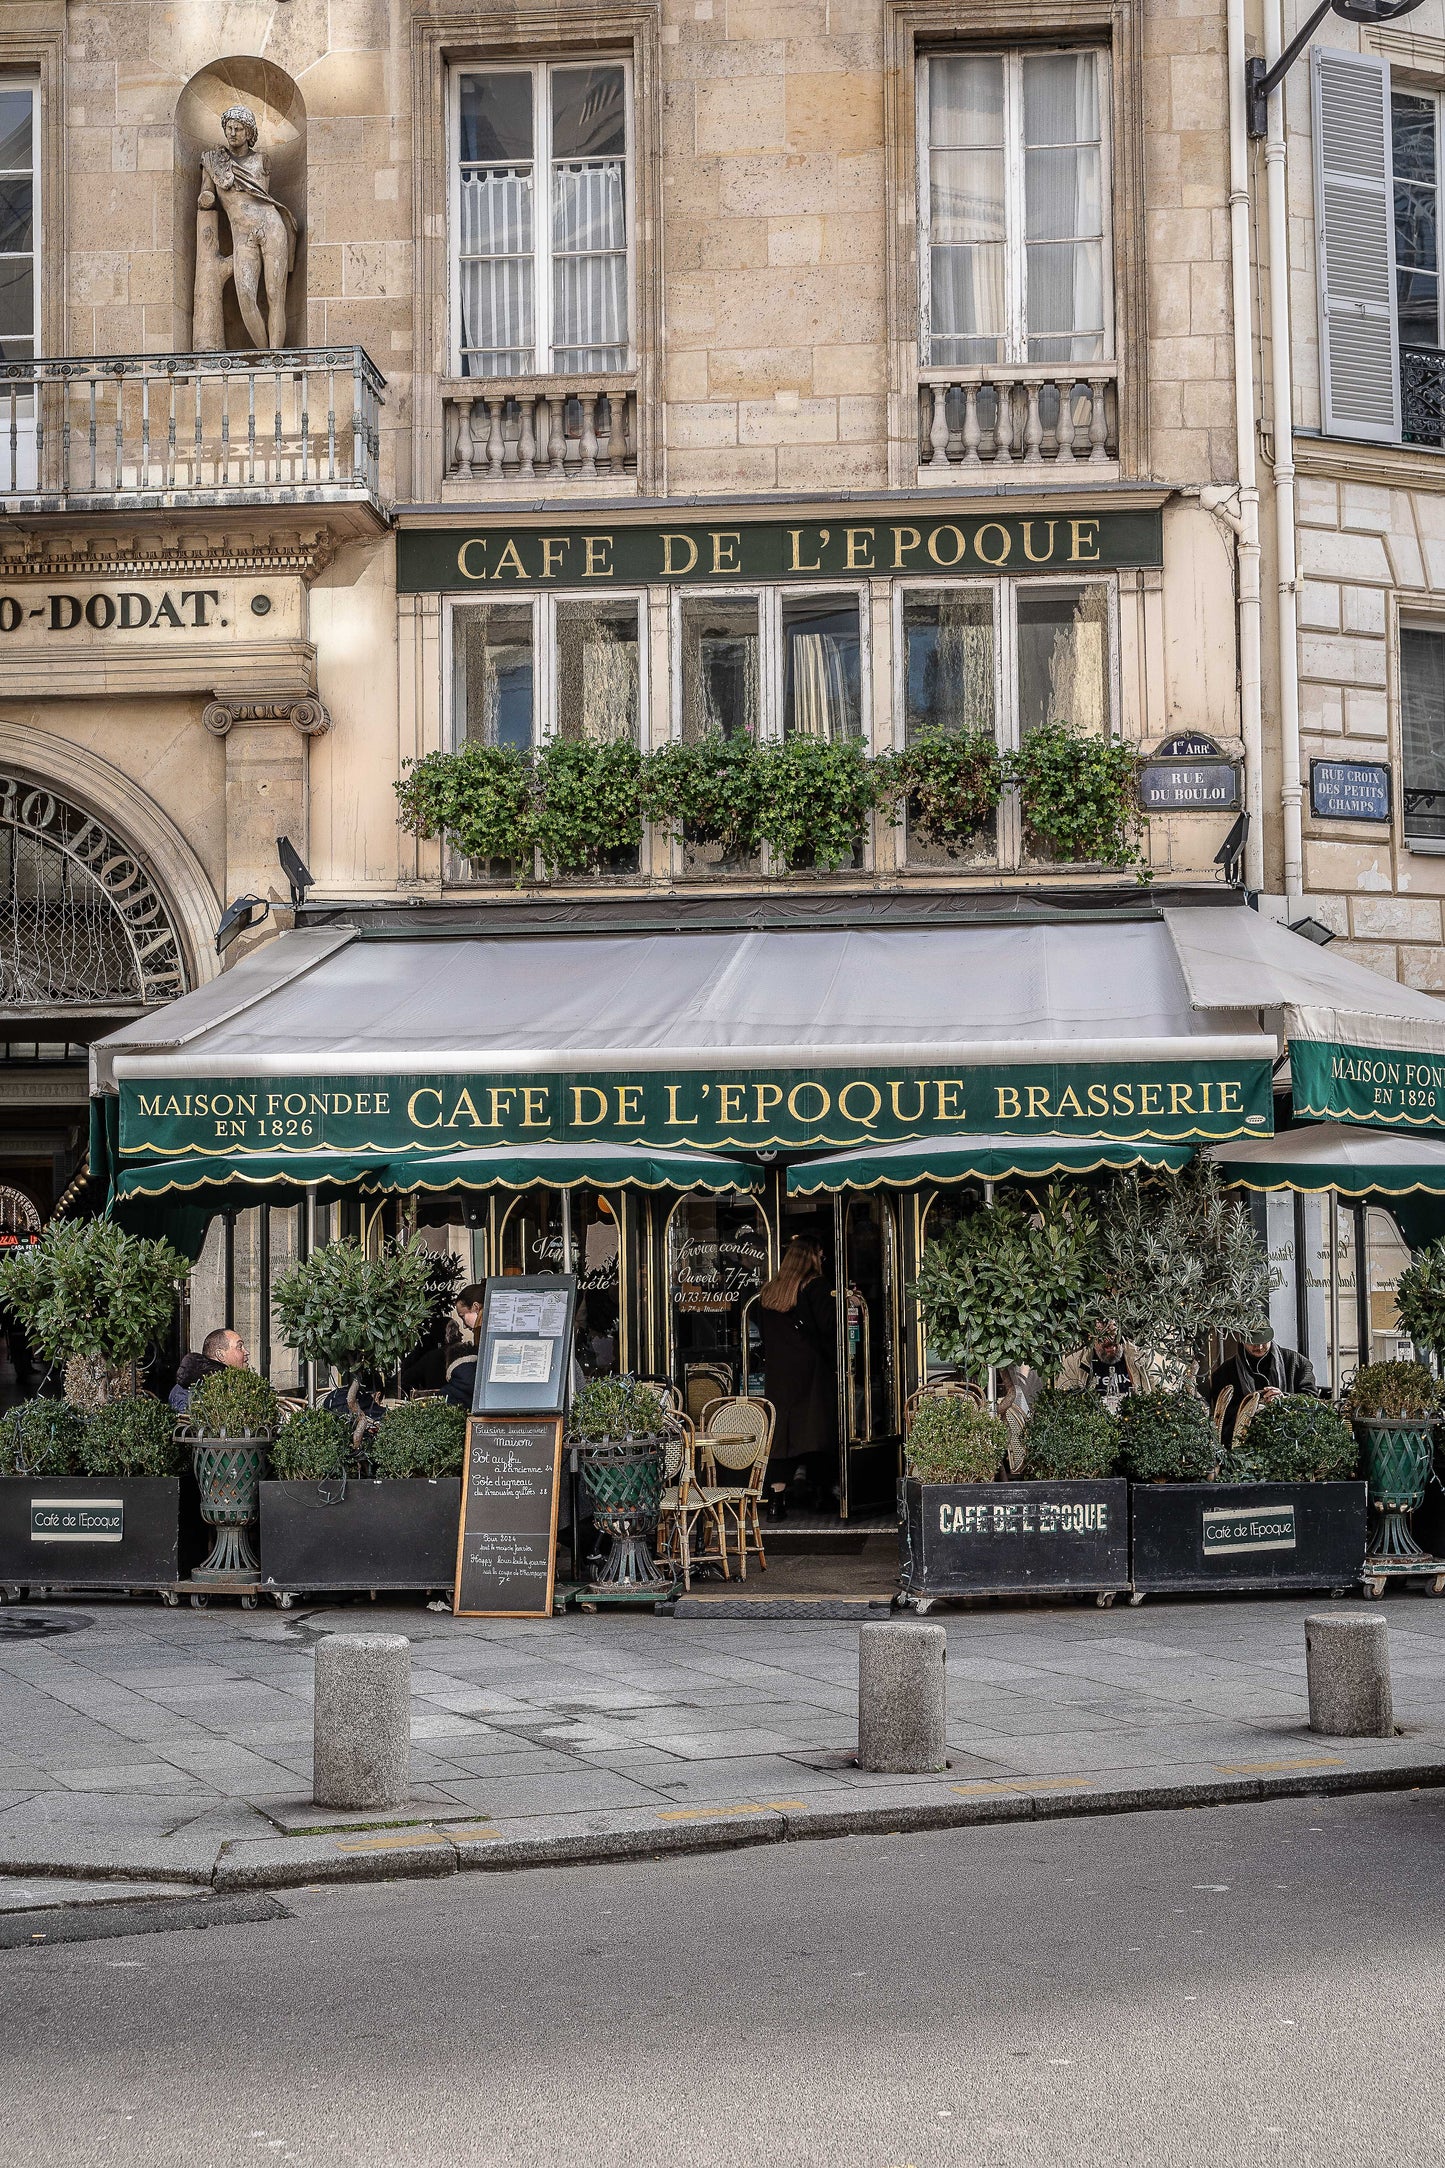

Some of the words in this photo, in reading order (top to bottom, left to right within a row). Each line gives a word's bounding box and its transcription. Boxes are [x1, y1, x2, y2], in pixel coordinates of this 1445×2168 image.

[457, 535, 614, 580] CAFE
[659, 532, 741, 575] DE
[787, 519, 1100, 571] L'EPOQUE
[1171, 772, 1204, 784] RUE
[1321, 768, 1344, 781] RUE
[1347, 771, 1380, 783] CROIX
[1150, 789, 1170, 801] DU
[1174, 788, 1226, 800] BOULOI
[1318, 782, 1340, 794] DES
[1344, 785, 1384, 798] PETITS
[1328, 799, 1377, 813] CHAMPS.
[1331, 1056, 1400, 1085] MAISON
[1405, 1064, 1445, 1088] FON
[138, 1094, 257, 1116] MAISON
[266, 1093, 391, 1115] FONDEE
[407, 1087, 552, 1129] CAFE
[569, 1086, 646, 1126] DE
[663, 1080, 966, 1128] L'EPOQUE
[994, 1082, 1244, 1118] BRASSERIE
[1373, 1087, 1393, 1104] EN
[1400, 1089, 1436, 1107] 1826
[215, 1121, 247, 1136] EN
[258, 1119, 313, 1136] 1826
[672, 1238, 716, 1266] Service
[720, 1241, 765, 1260] continu
[678, 1266, 719, 1283] Ouvert
[674, 1291, 740, 1303] 01.73.71.61.02
[472, 1447, 490, 1463] Pot
[34, 1512, 60, 1526] Café
[62, 1513, 76, 1526] de
[1206, 1525, 1231, 1539] Café
[1233, 1523, 1248, 1537] de
